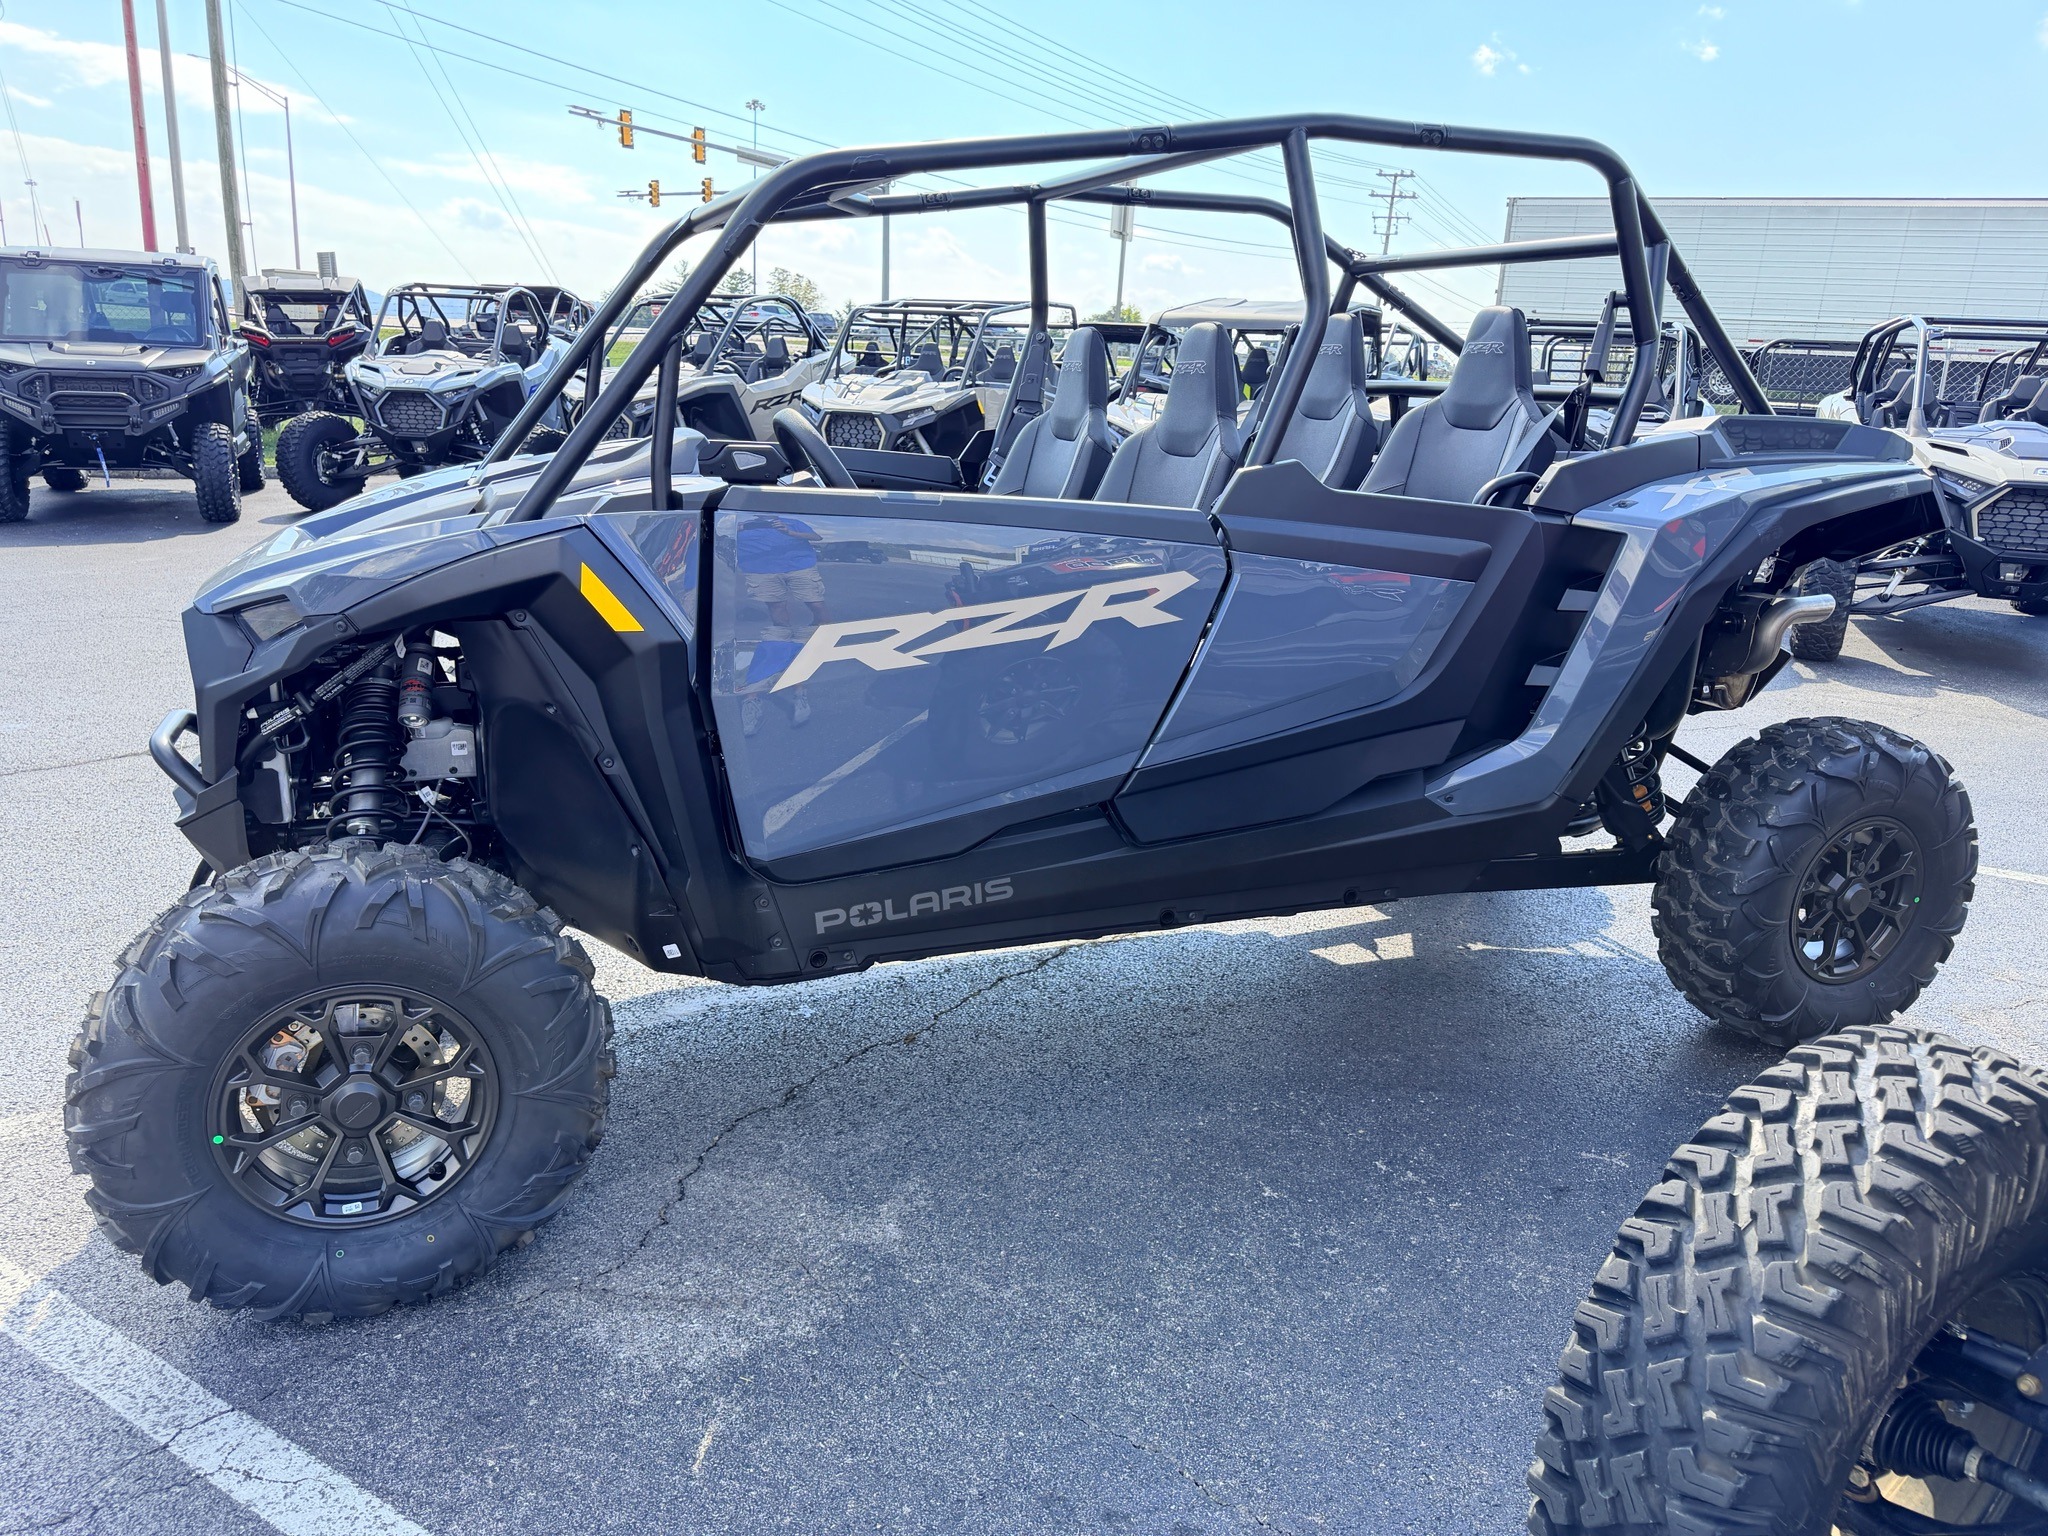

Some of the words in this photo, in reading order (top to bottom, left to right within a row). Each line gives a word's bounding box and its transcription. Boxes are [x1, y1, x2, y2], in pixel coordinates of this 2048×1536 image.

[1319, 343, 1343, 355] ZR
[1462, 341, 1505, 356] RZR
[1173, 360, 1207, 375] RZR
[768, 570, 1200, 694] RZR
[814, 877, 1014, 935] POLARIS
